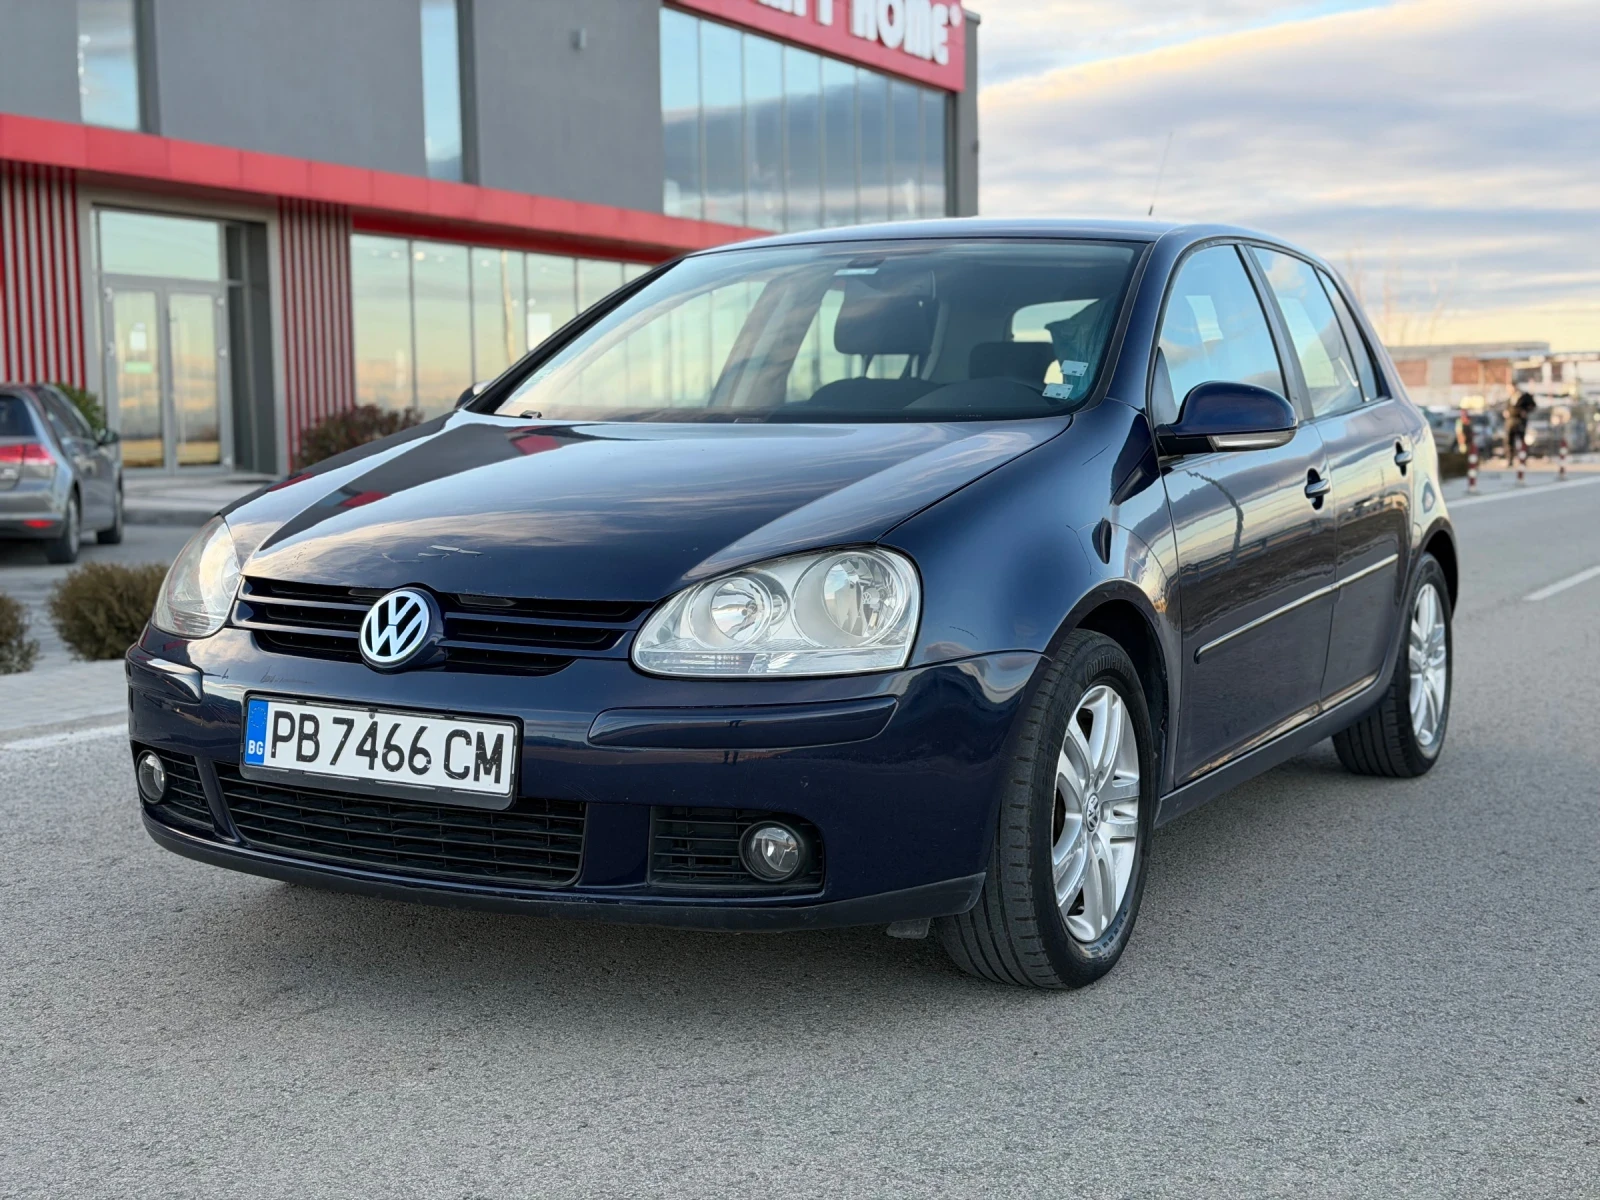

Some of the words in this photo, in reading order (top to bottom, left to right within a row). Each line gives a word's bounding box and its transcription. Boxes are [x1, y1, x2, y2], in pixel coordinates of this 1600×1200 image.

[247, 739, 265, 756] BG
[270, 710, 321, 763] PB
[329, 716, 432, 776] 7466
[443, 729, 505, 784] CM
